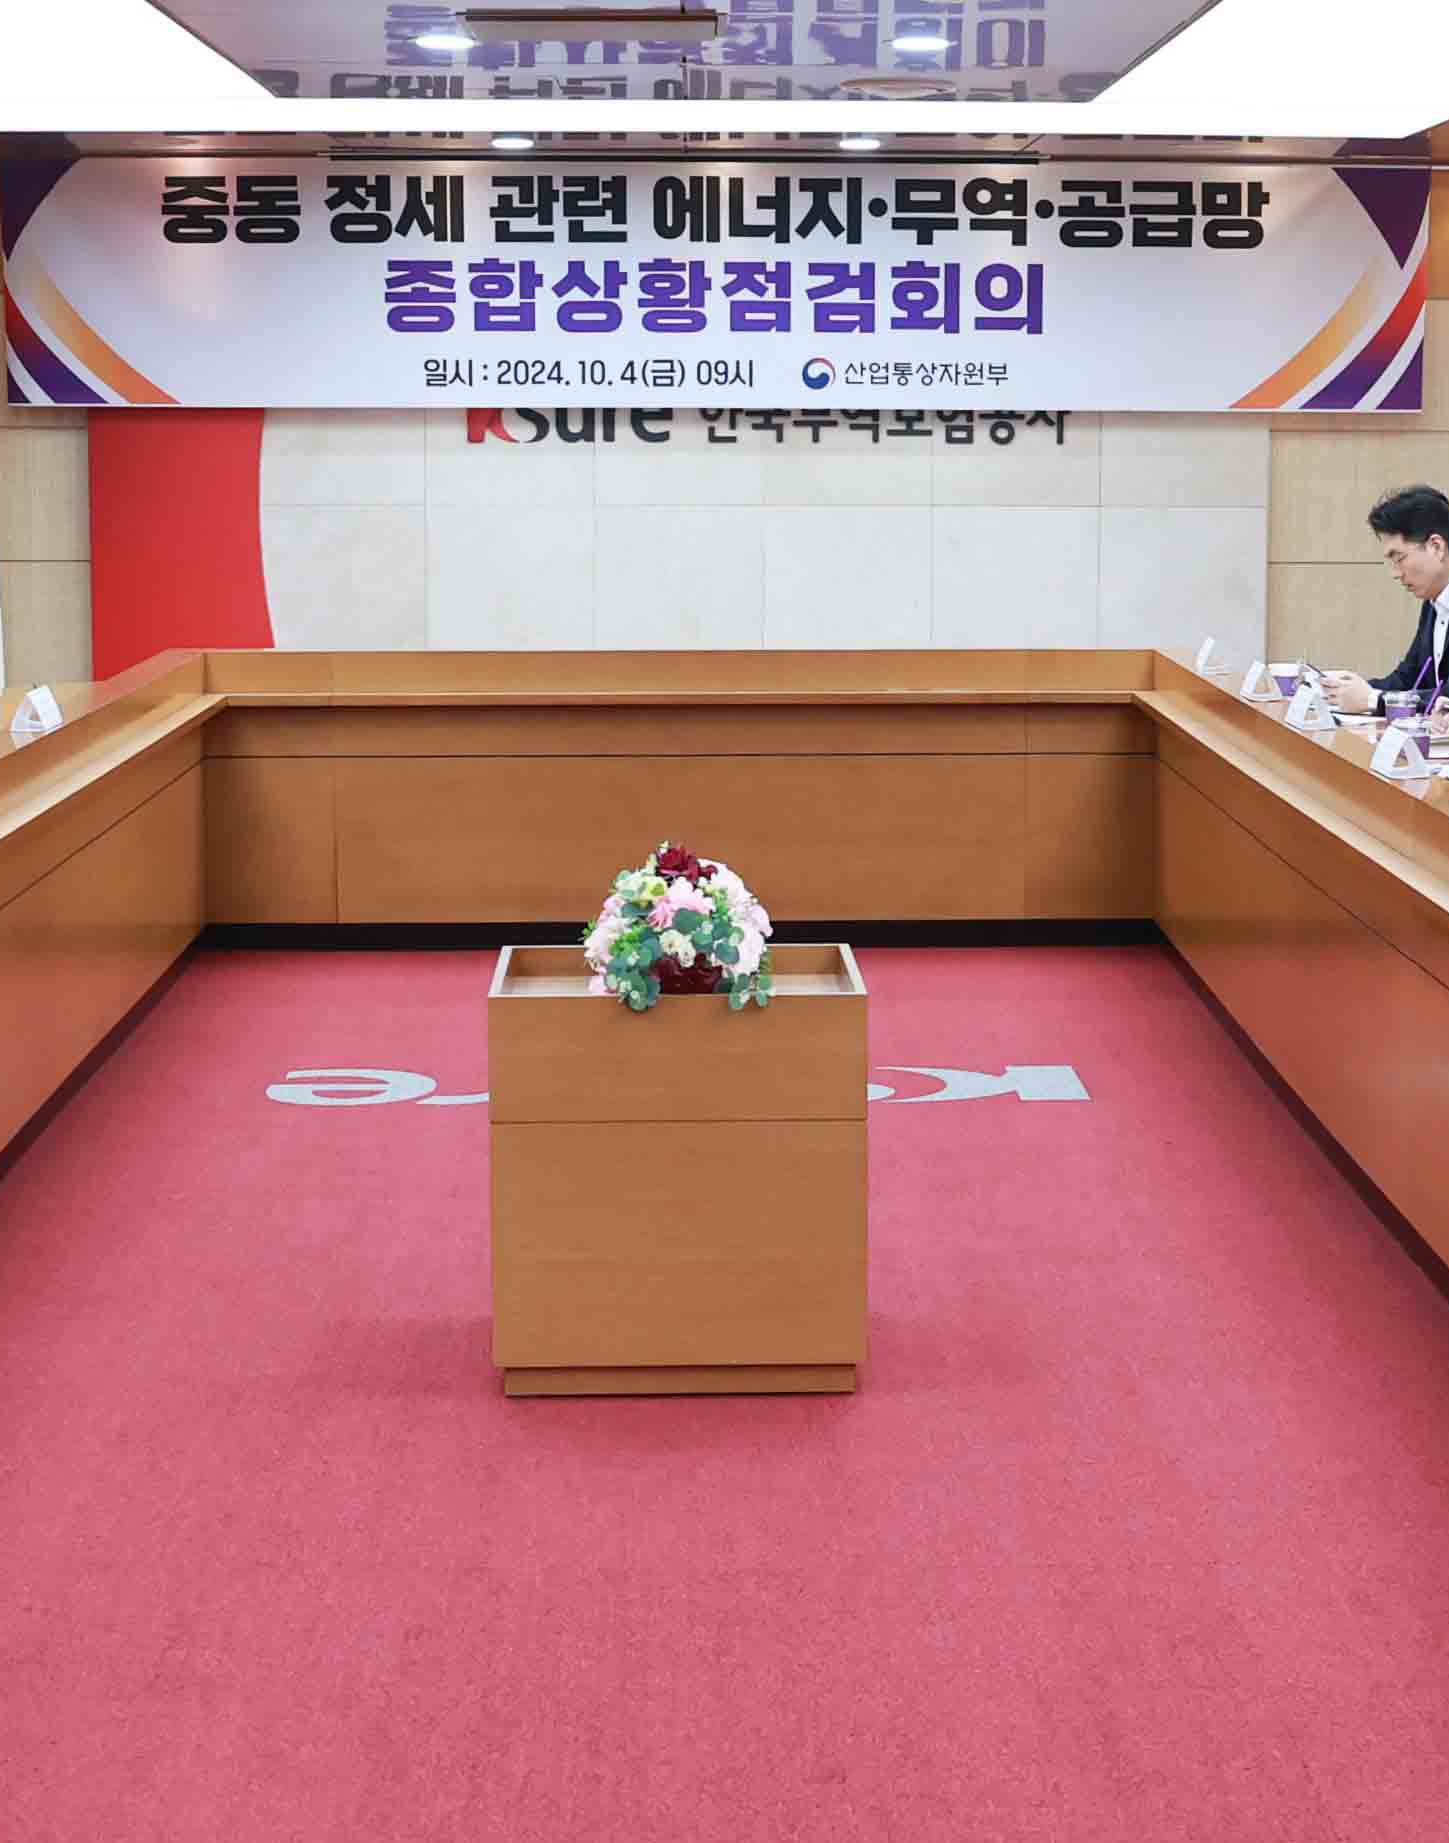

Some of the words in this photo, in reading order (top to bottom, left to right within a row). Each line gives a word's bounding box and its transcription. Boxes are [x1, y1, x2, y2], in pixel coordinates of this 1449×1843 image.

[160, 175, 302, 244] 중동
[323, 175, 465, 244] 정세
[489, 175, 628, 243] 관련
[383, 257, 1044, 335] 종합상황점검회의
[696, 359, 754, 388] 09시
[844, 362, 1009, 387] 산업통상자원부
